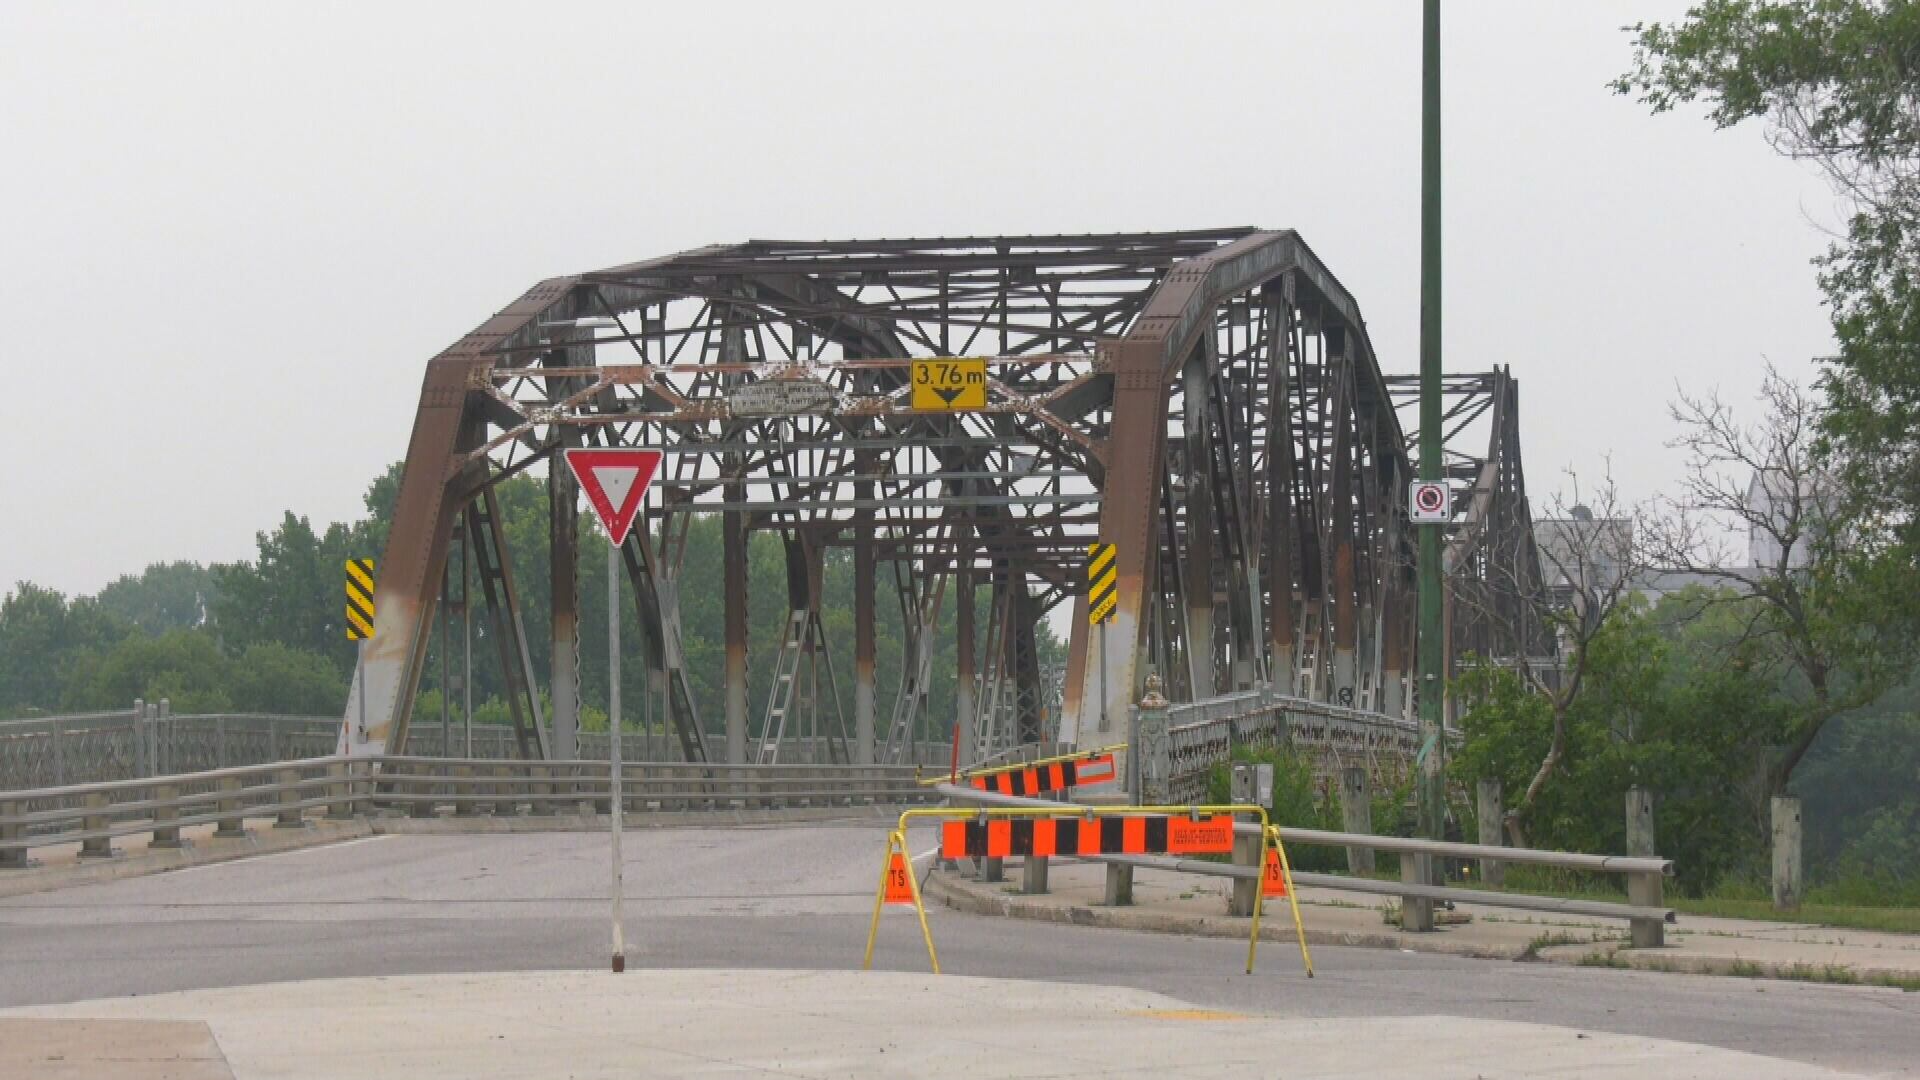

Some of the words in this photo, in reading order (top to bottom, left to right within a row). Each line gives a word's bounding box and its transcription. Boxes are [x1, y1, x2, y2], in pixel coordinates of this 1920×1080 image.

[916, 363, 962, 385] 3.76
[966, 371, 983, 385] m
[890, 869, 905, 887] TS
[1267, 863, 1278, 881] TS
